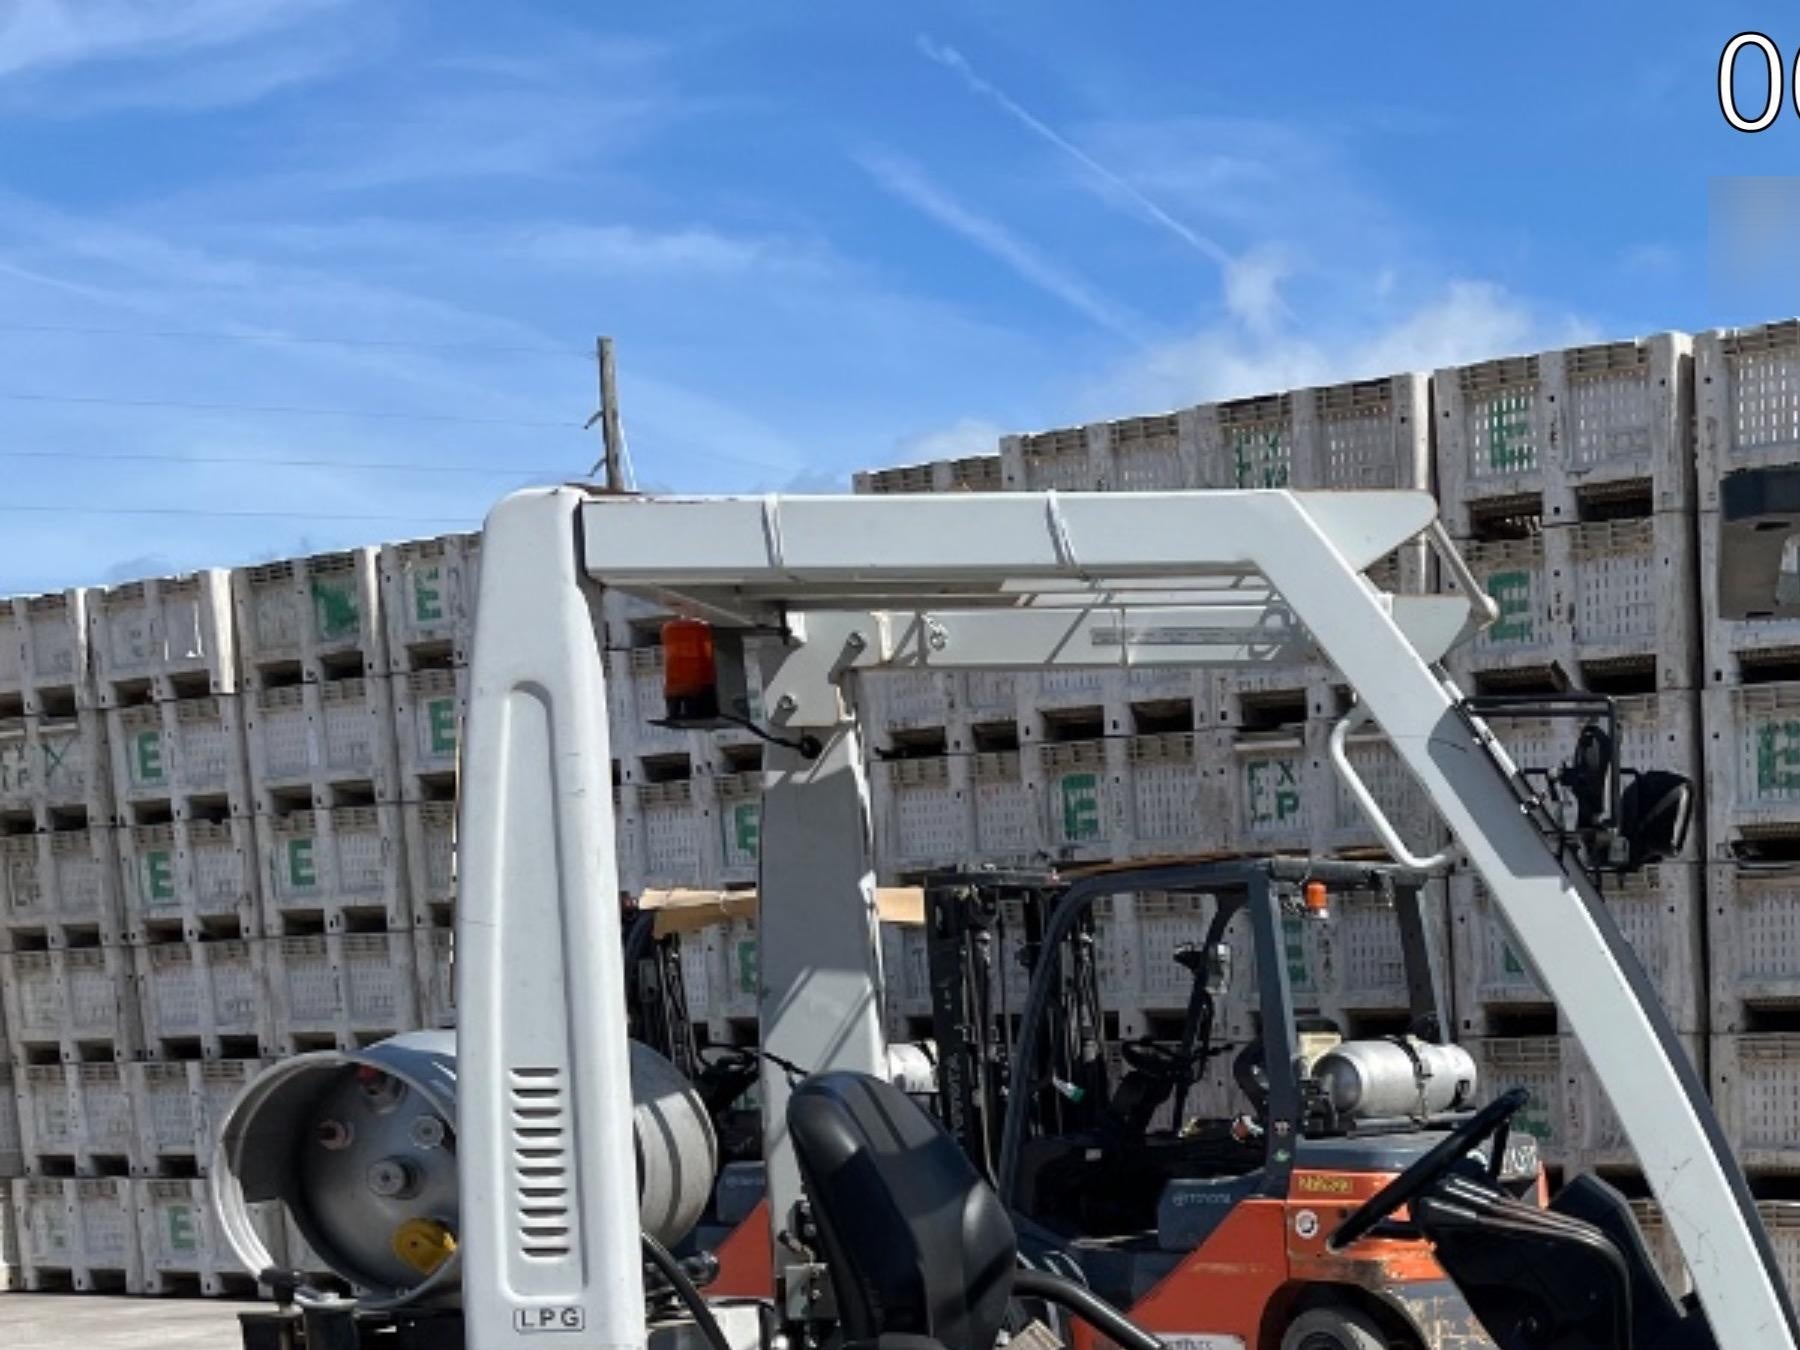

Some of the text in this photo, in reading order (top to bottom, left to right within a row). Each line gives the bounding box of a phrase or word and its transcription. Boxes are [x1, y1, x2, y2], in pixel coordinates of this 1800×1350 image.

[1488, 570, 1532, 642] E
[429, 700, 457, 752] E
[136, 731, 162, 779] E
[146, 851, 174, 900] E
[286, 839, 316, 888] E
[169, 1205, 194, 1250] E
[520, 1306, 580, 1328] LPG
